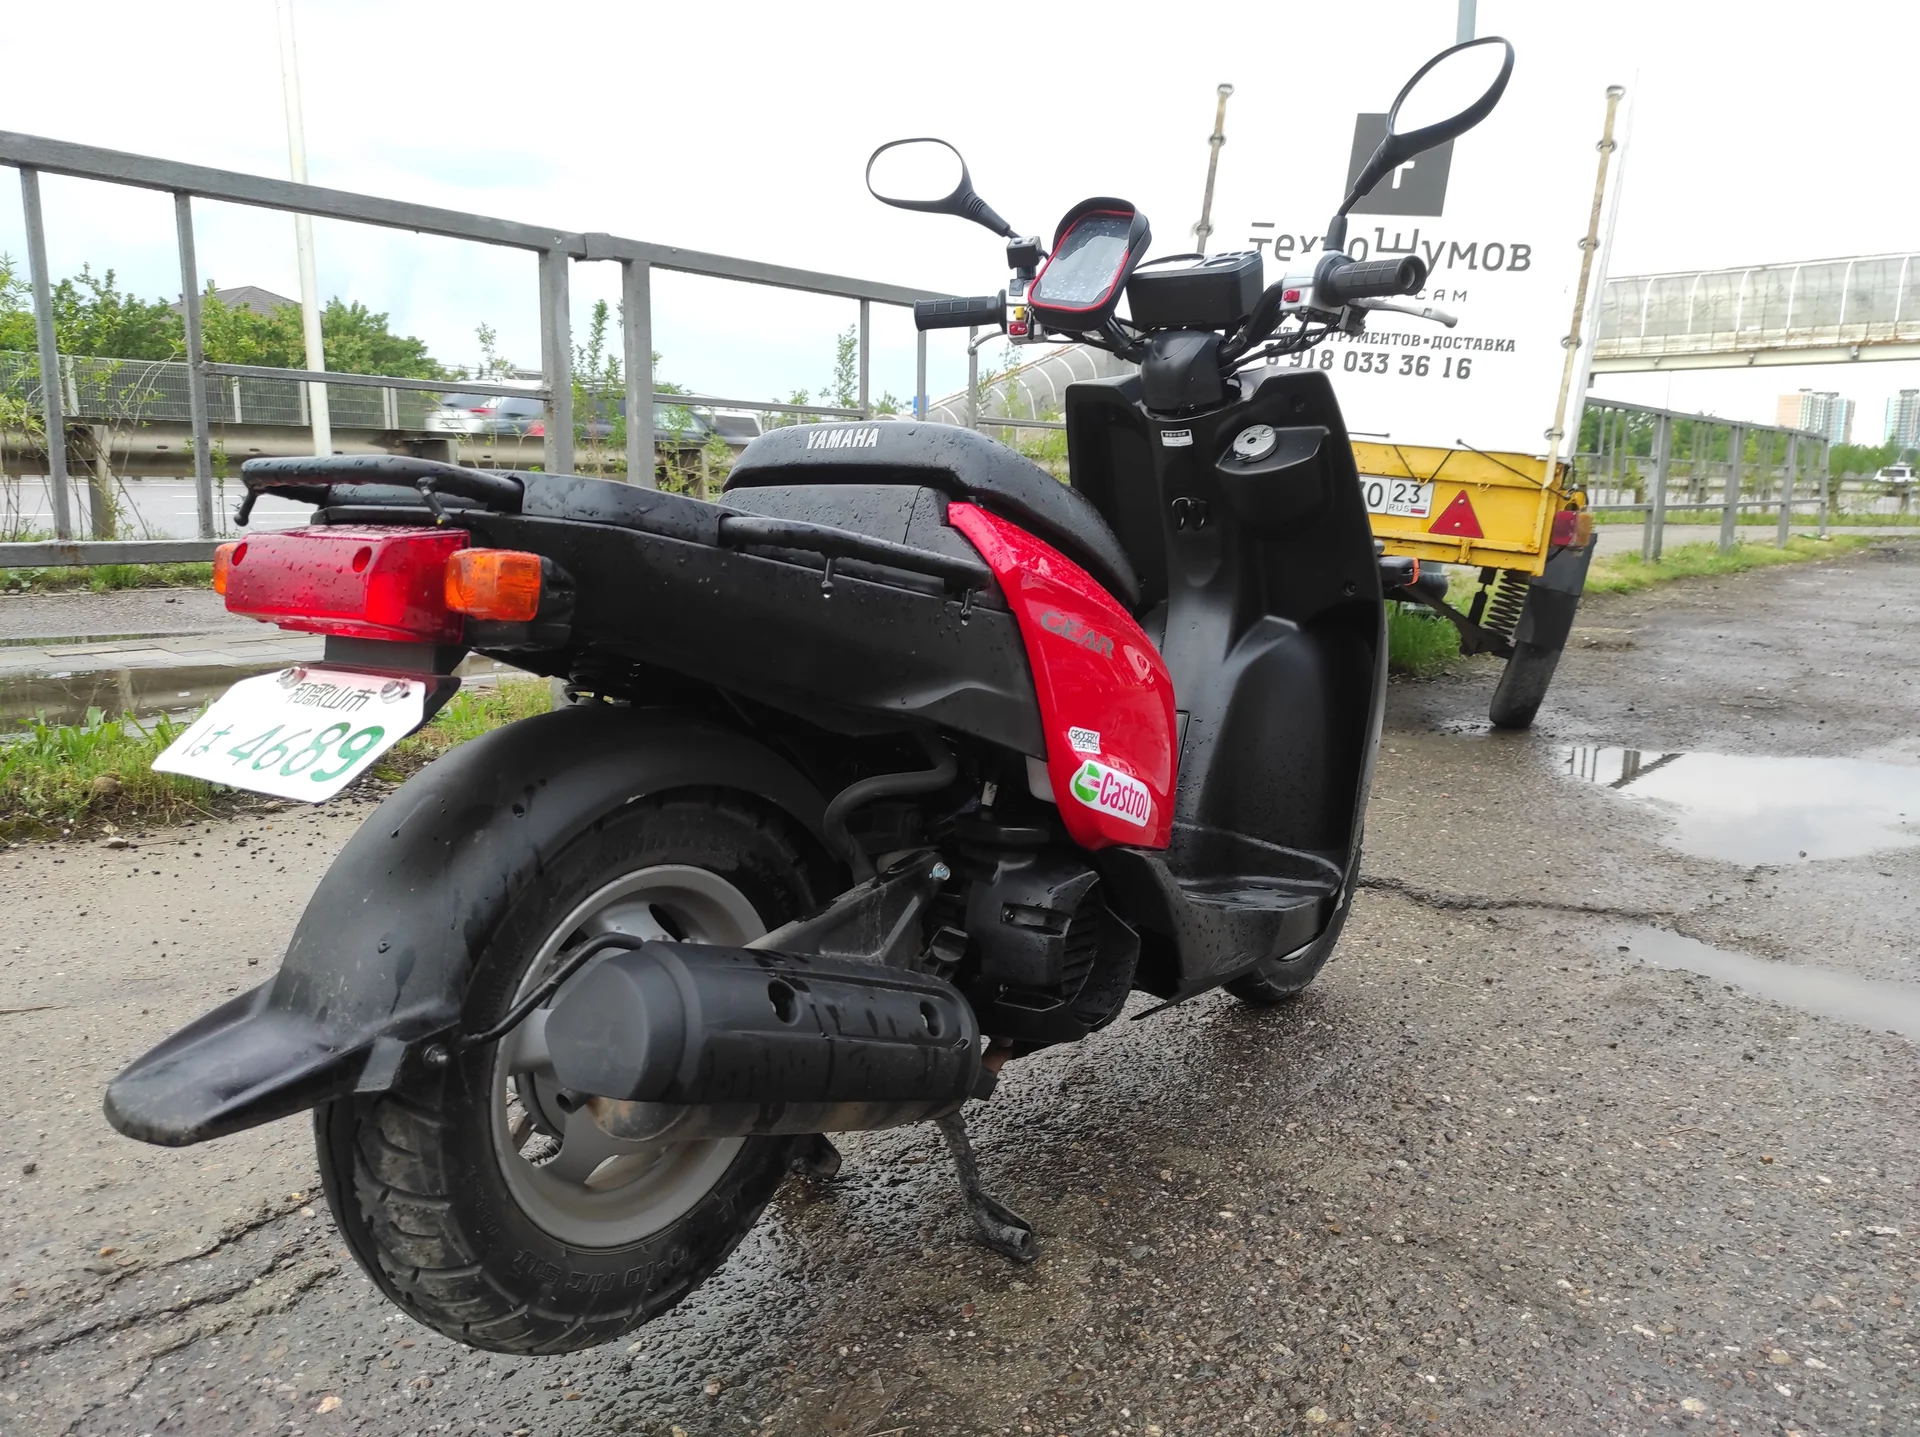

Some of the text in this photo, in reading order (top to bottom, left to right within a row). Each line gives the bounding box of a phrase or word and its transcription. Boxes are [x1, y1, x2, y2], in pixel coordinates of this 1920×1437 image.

[1248, 222, 1532, 278] ТехоШумов
[1430, 335, 1516, 352] ДОСТАВКА
[1289, 348, 1335, 370] 918
[1343, 350, 1390, 374] 033
[1398, 354, 1431, 377] 36
[1442, 357, 1473, 380] 16
[806, 427, 880, 450] YAMAHA
[1388, 503, 1410, 513] RUS
[1393, 483, 1422, 504] 23
[1041, 611, 1115, 660] GEAR
[286, 681, 378, 713] 和歌山市
[181, 721, 386, 783] は 4689
[1099, 771, 1151, 822] Castrol
